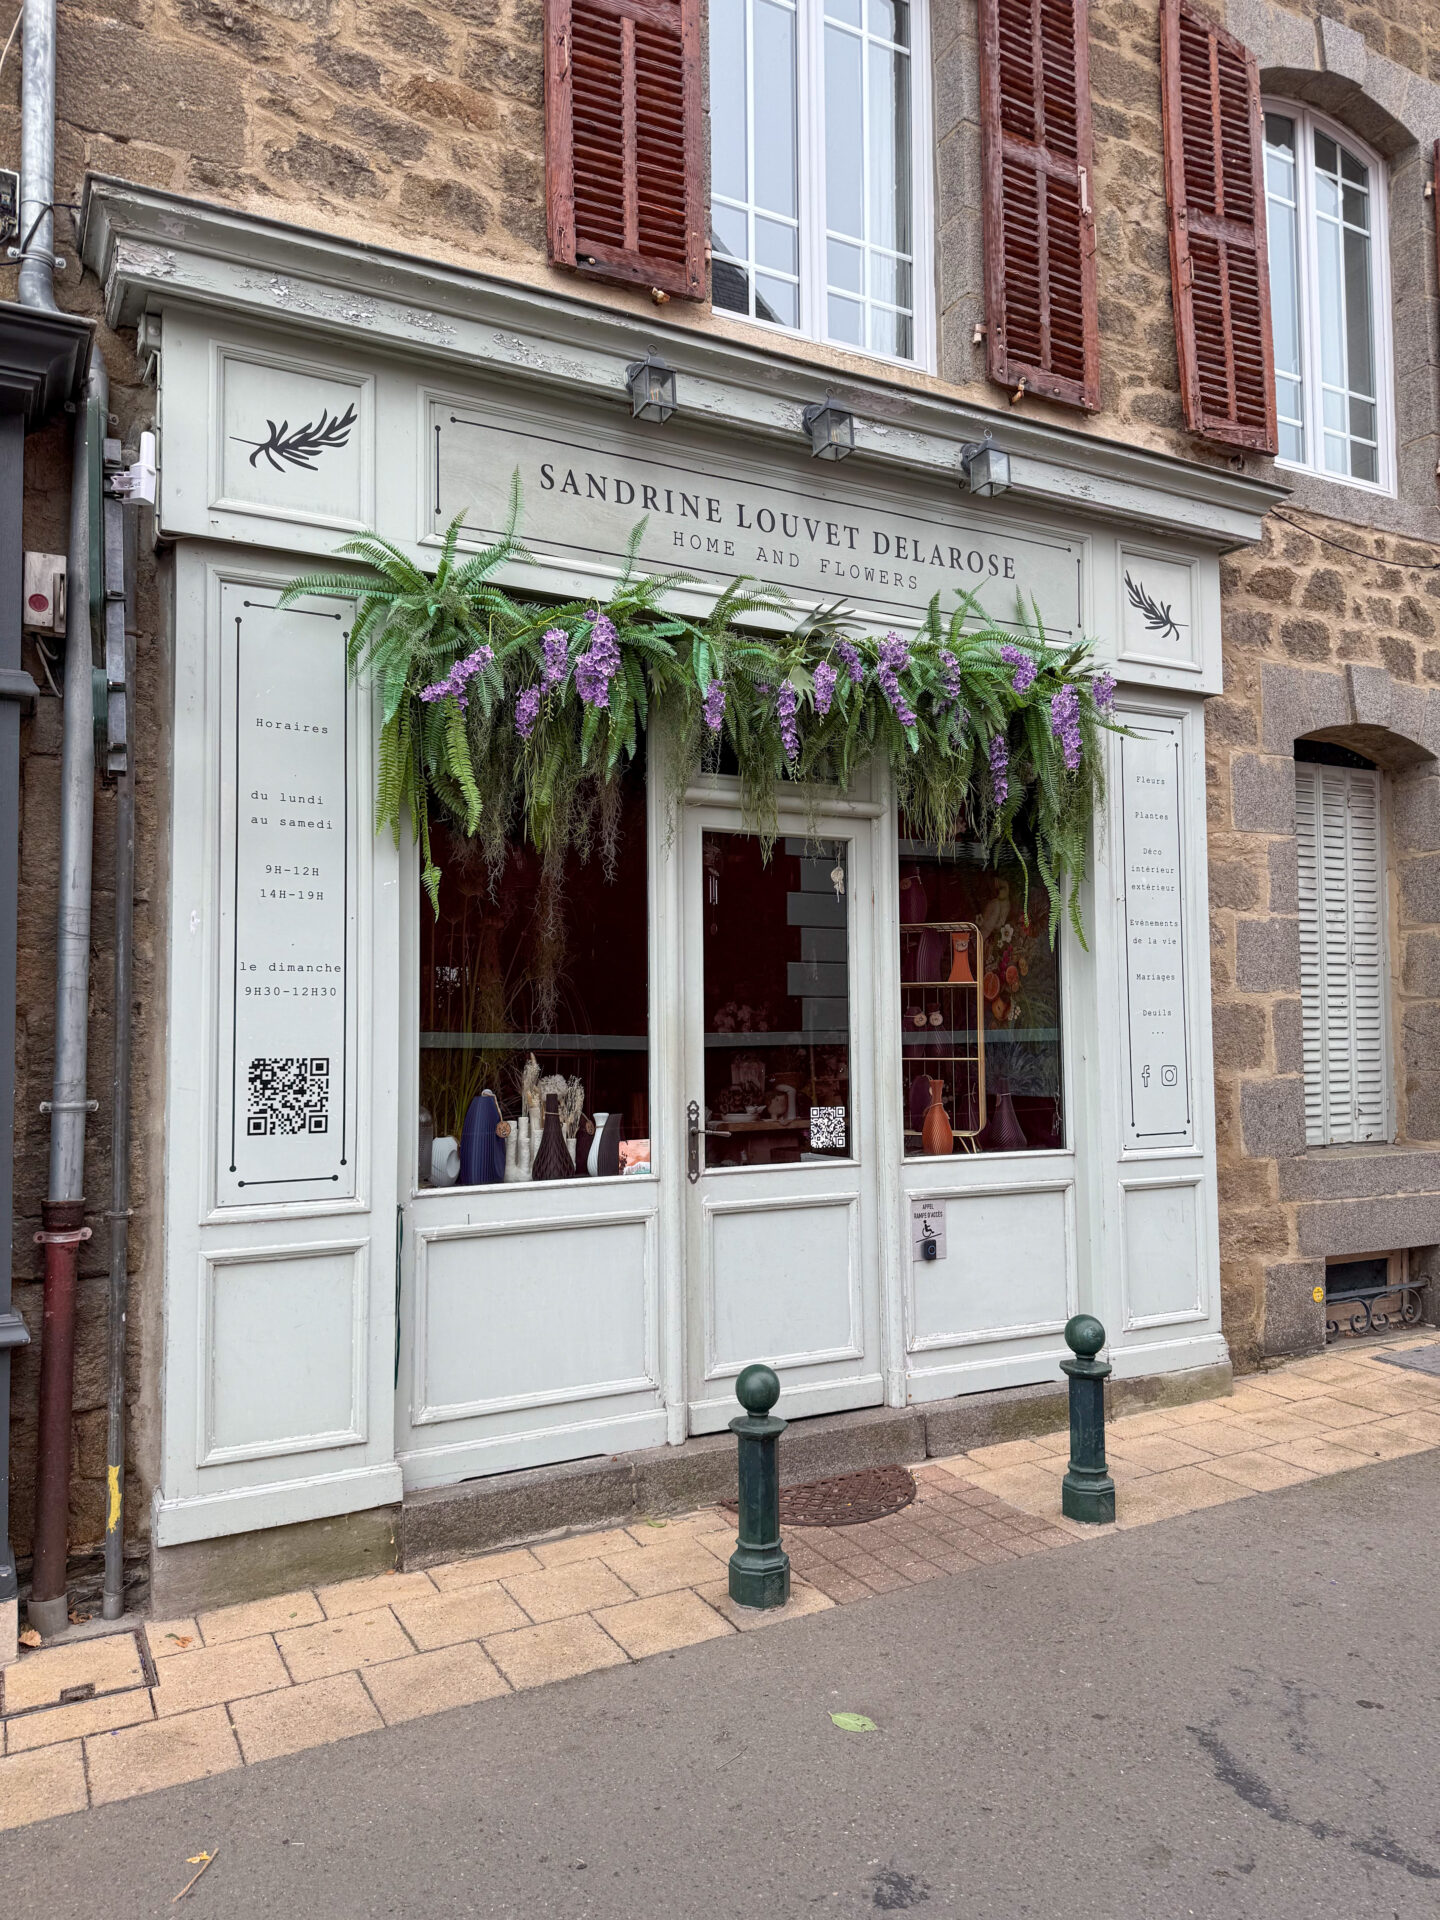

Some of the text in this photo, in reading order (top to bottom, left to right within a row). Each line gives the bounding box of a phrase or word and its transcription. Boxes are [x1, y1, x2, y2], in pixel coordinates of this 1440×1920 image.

[540, 463, 1017, 580] SANDRINE LOUVET DELAROSE
[672, 530, 919, 590] HOME AND FLOWERS
[256, 717, 328, 735] Horaires
[1136, 775, 1165, 785] Fleurs
[250, 790, 324, 805] du lundi
[1135, 811, 1169, 821] Plantes
[250, 816, 333, 830] au samedi
[265, 864, 319, 877] 9H-12H
[260, 888, 324, 901] 14H-19H
[1132, 936, 1178, 946] de la vie
[239, 961, 342, 973] le dimanche
[1136, 973, 1175, 982] Mariages
[245, 986, 337, 997] 9H30-12H30
[1142, 1009, 1172, 1017] Deuils
